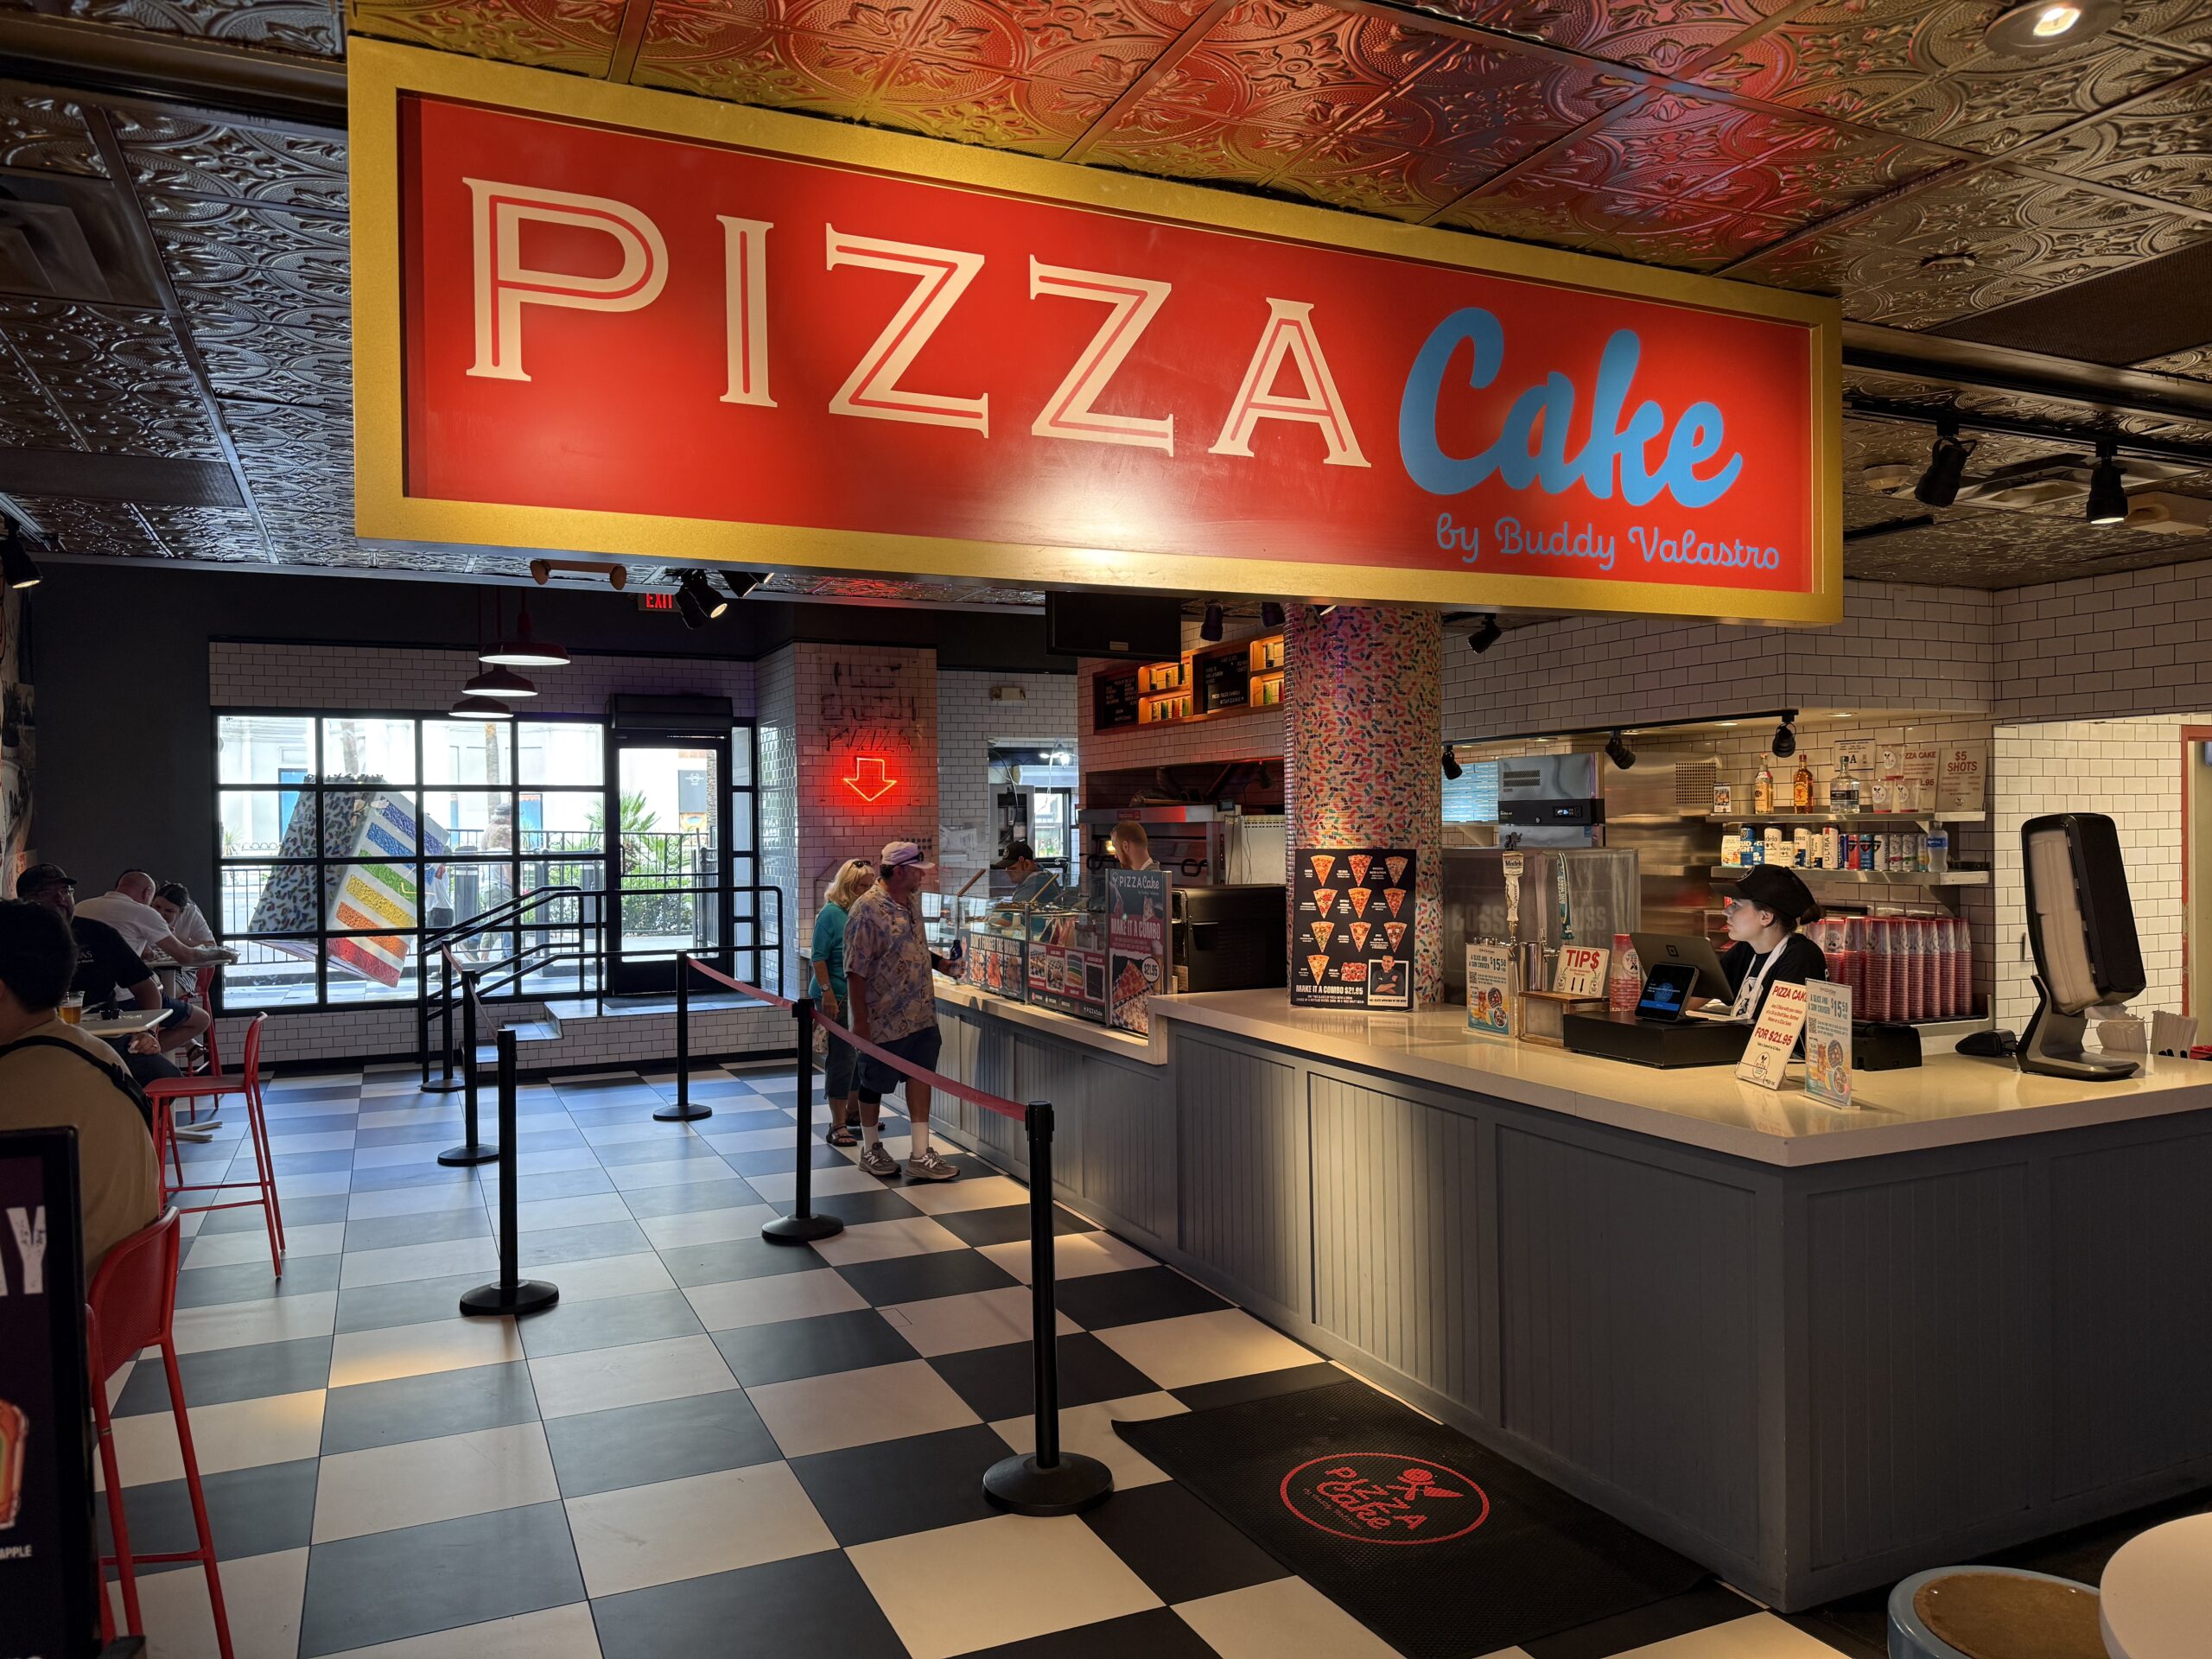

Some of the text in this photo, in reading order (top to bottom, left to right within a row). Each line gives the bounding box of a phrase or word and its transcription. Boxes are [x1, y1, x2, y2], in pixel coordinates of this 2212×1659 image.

[462, 177, 1743, 507] PIZZA Cake
[1435, 511, 1781, 572] by Buddy Valastro
[645, 592, 674, 609] EXIT
[1955, 751, 1967, 761] $5
[1947, 761, 1977, 772] SHOTS
[1119, 875, 1160, 889] PIZZA Cake
[1111, 918, 1160, 940] MAKE IT A COMBO
[1144, 963, 1158, 977] $21.95
[1296, 985, 1312, 993] MAKE
[1323, 986, 1344, 994] COMBO
[1344, 987, 1363, 995] $21.95
[1772, 985, 1791, 999] PIZZA
[1755, 1027, 1793, 1046] FOR $21.95
[1316, 1480, 1391, 1530] Cake
[1325, 1466, 1427, 1530] PIZZA
